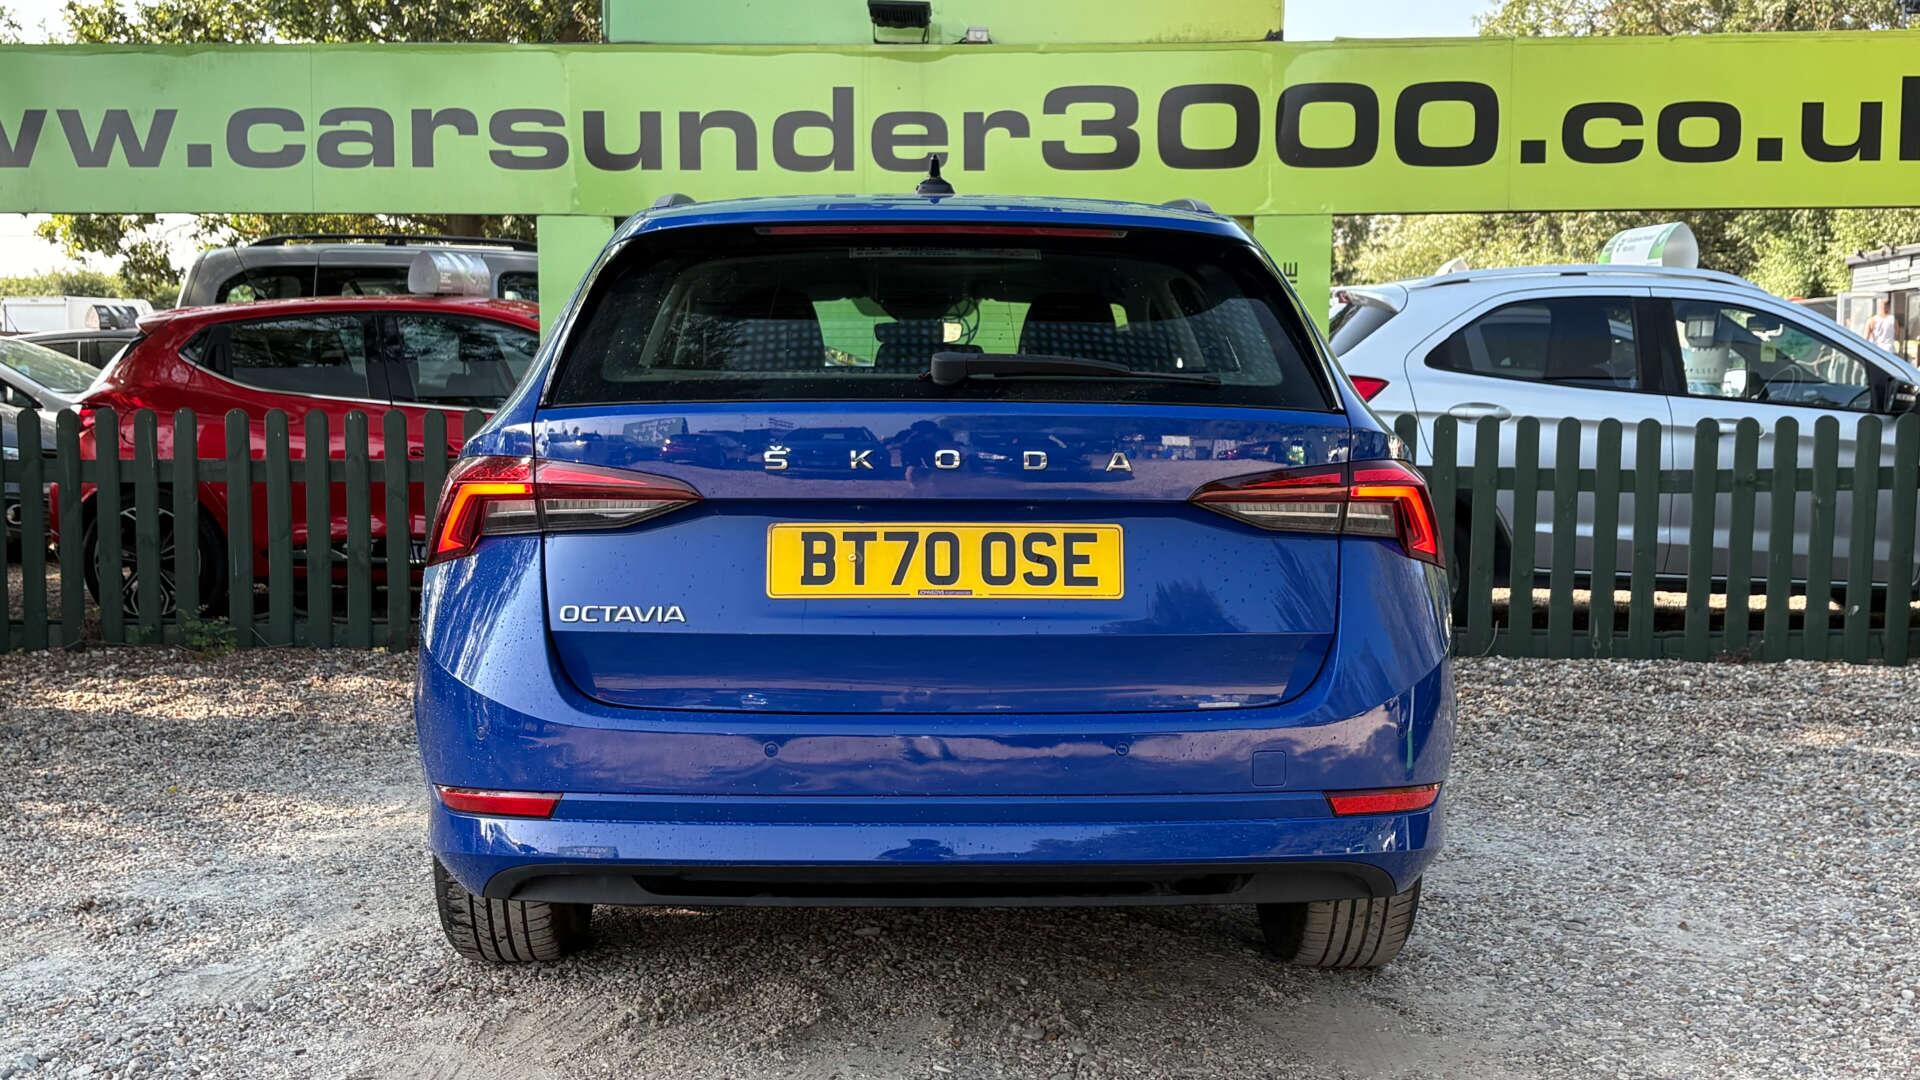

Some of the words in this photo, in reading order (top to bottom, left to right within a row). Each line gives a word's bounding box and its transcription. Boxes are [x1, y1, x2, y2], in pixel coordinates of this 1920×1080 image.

[763, 445, 1133, 472] ŠKODA
[801, 532, 960, 586] BT70
[981, 532, 1099, 586] OSE
[559, 605, 686, 623] OCTAVIA
